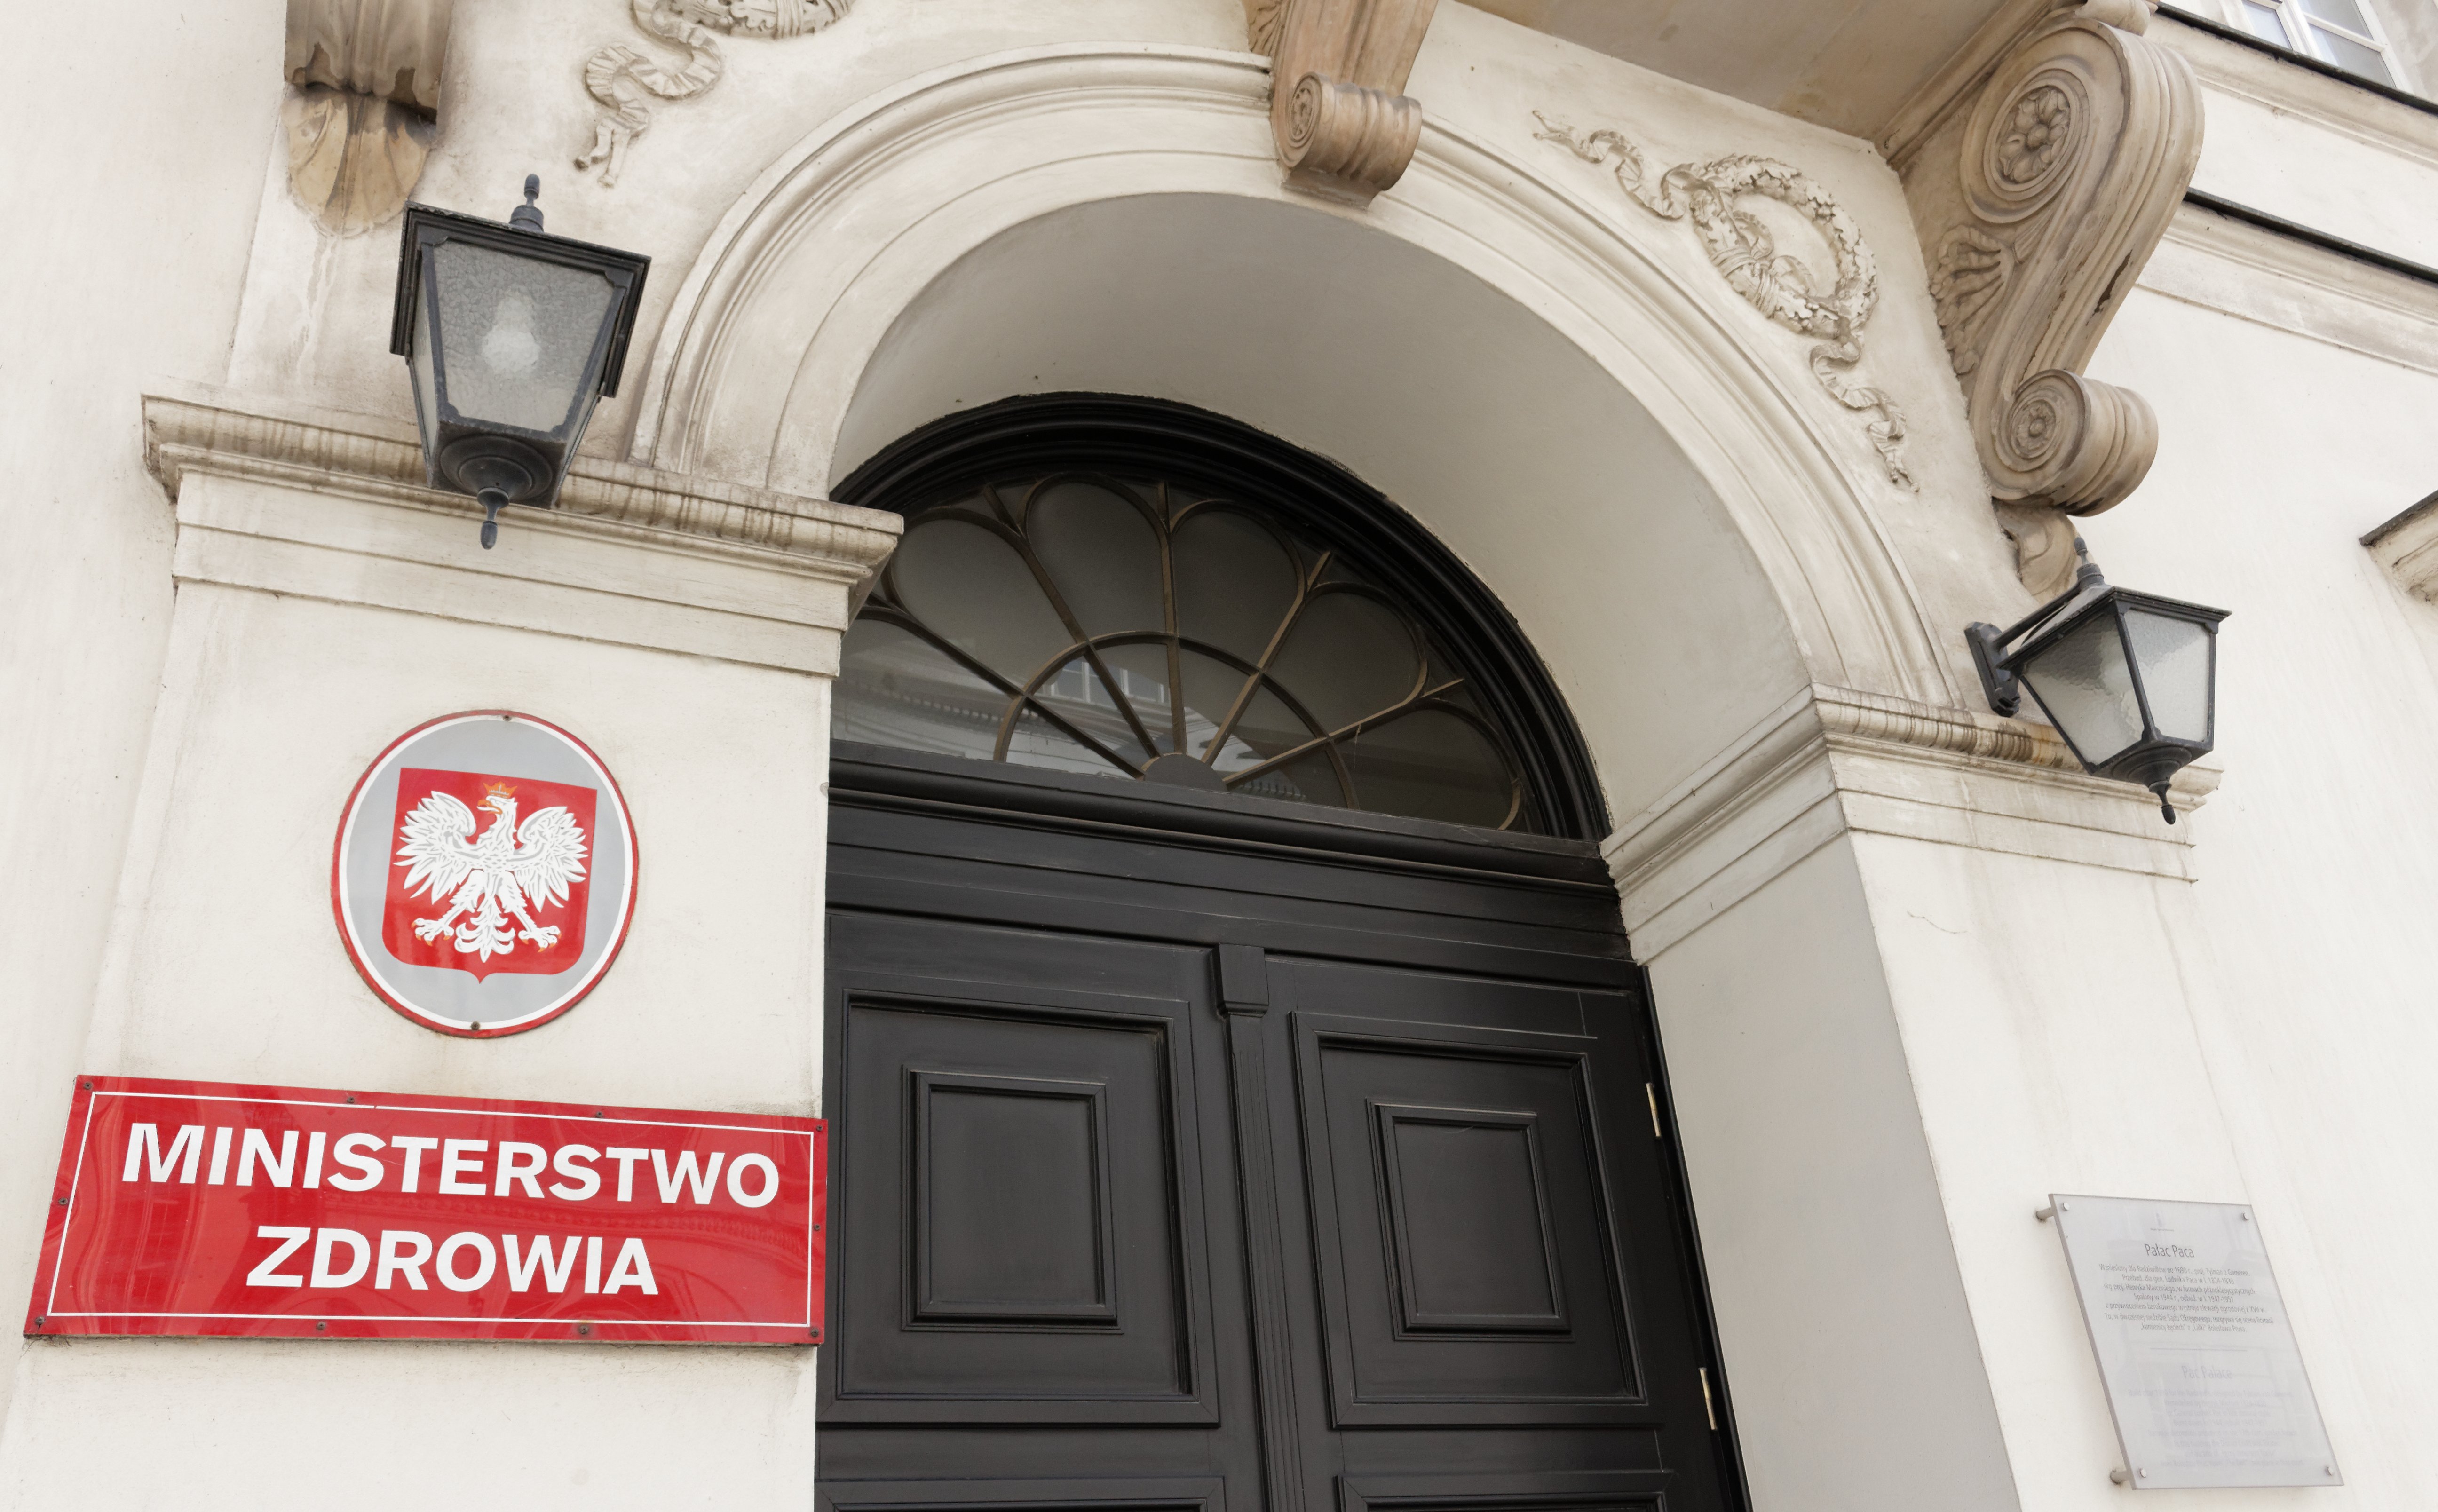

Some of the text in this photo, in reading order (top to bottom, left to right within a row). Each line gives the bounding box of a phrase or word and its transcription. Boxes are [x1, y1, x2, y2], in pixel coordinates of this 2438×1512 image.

[122, 1123, 779, 1208] MINISTERSTWO
[2145, 1243, 2194, 1258] Pałac Paca
[246, 1226, 658, 1294] ZDROWIA
[2099, 1264, 2127, 1273] Wzniesiony
[2133, 1293, 2153, 1302] Spalony
[2147, 1302, 2177, 1312] barokowego
[2178, 1304, 2199, 1313] wystroju
[2200, 1304, 2219, 1313] elewacji
[2181, 1365, 2232, 1379] Pac Palace
